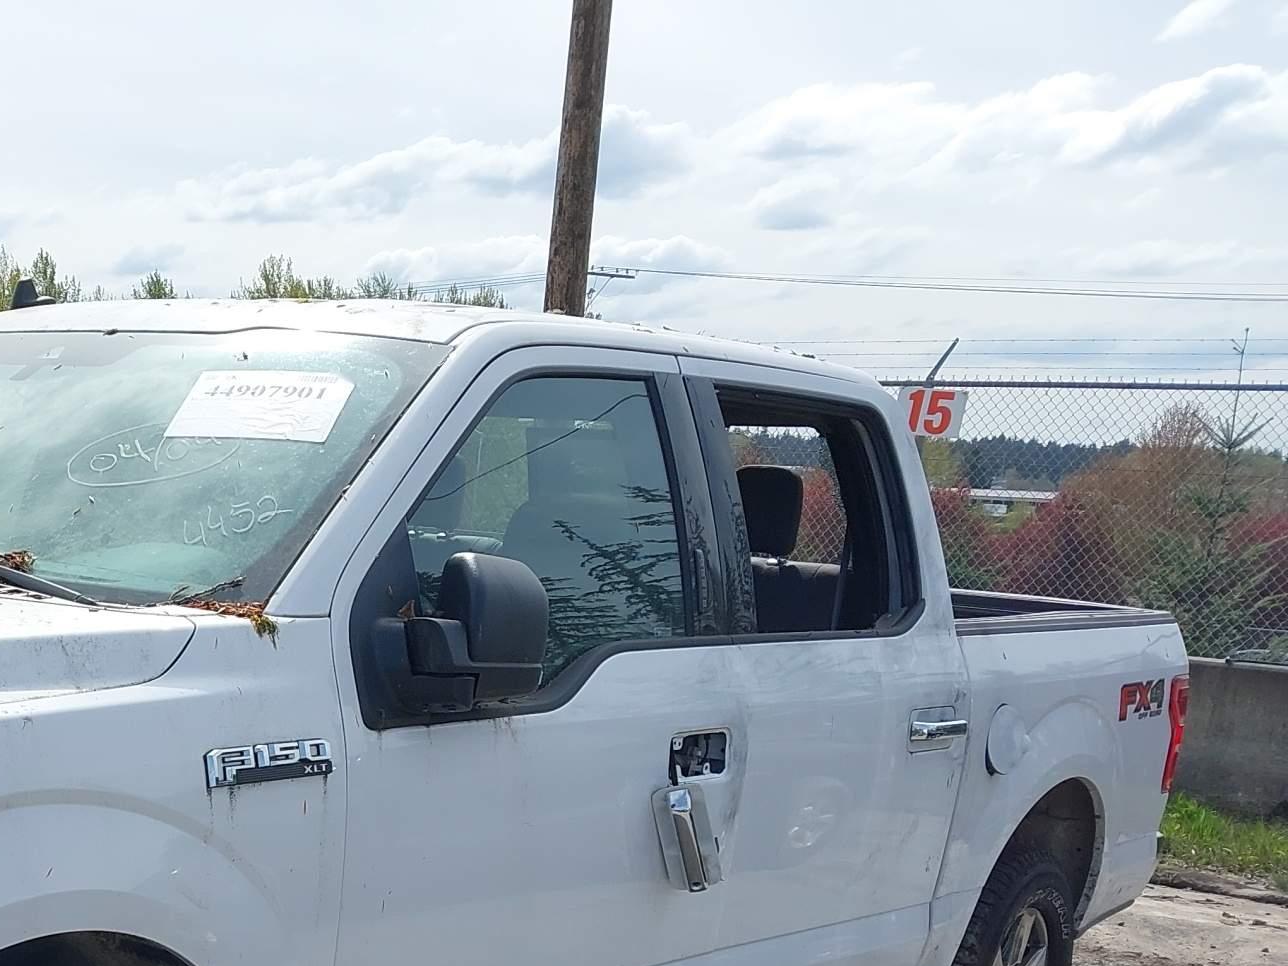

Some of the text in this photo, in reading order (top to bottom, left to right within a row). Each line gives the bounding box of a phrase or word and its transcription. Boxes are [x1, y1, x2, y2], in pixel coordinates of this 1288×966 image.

[204, 384, 327, 400] 44907901
[908, 389, 957, 436] 15
[183, 496, 294, 547] 4452
[1118, 678, 1165, 721] FX4
[304, 763, 328, 775] XLT
